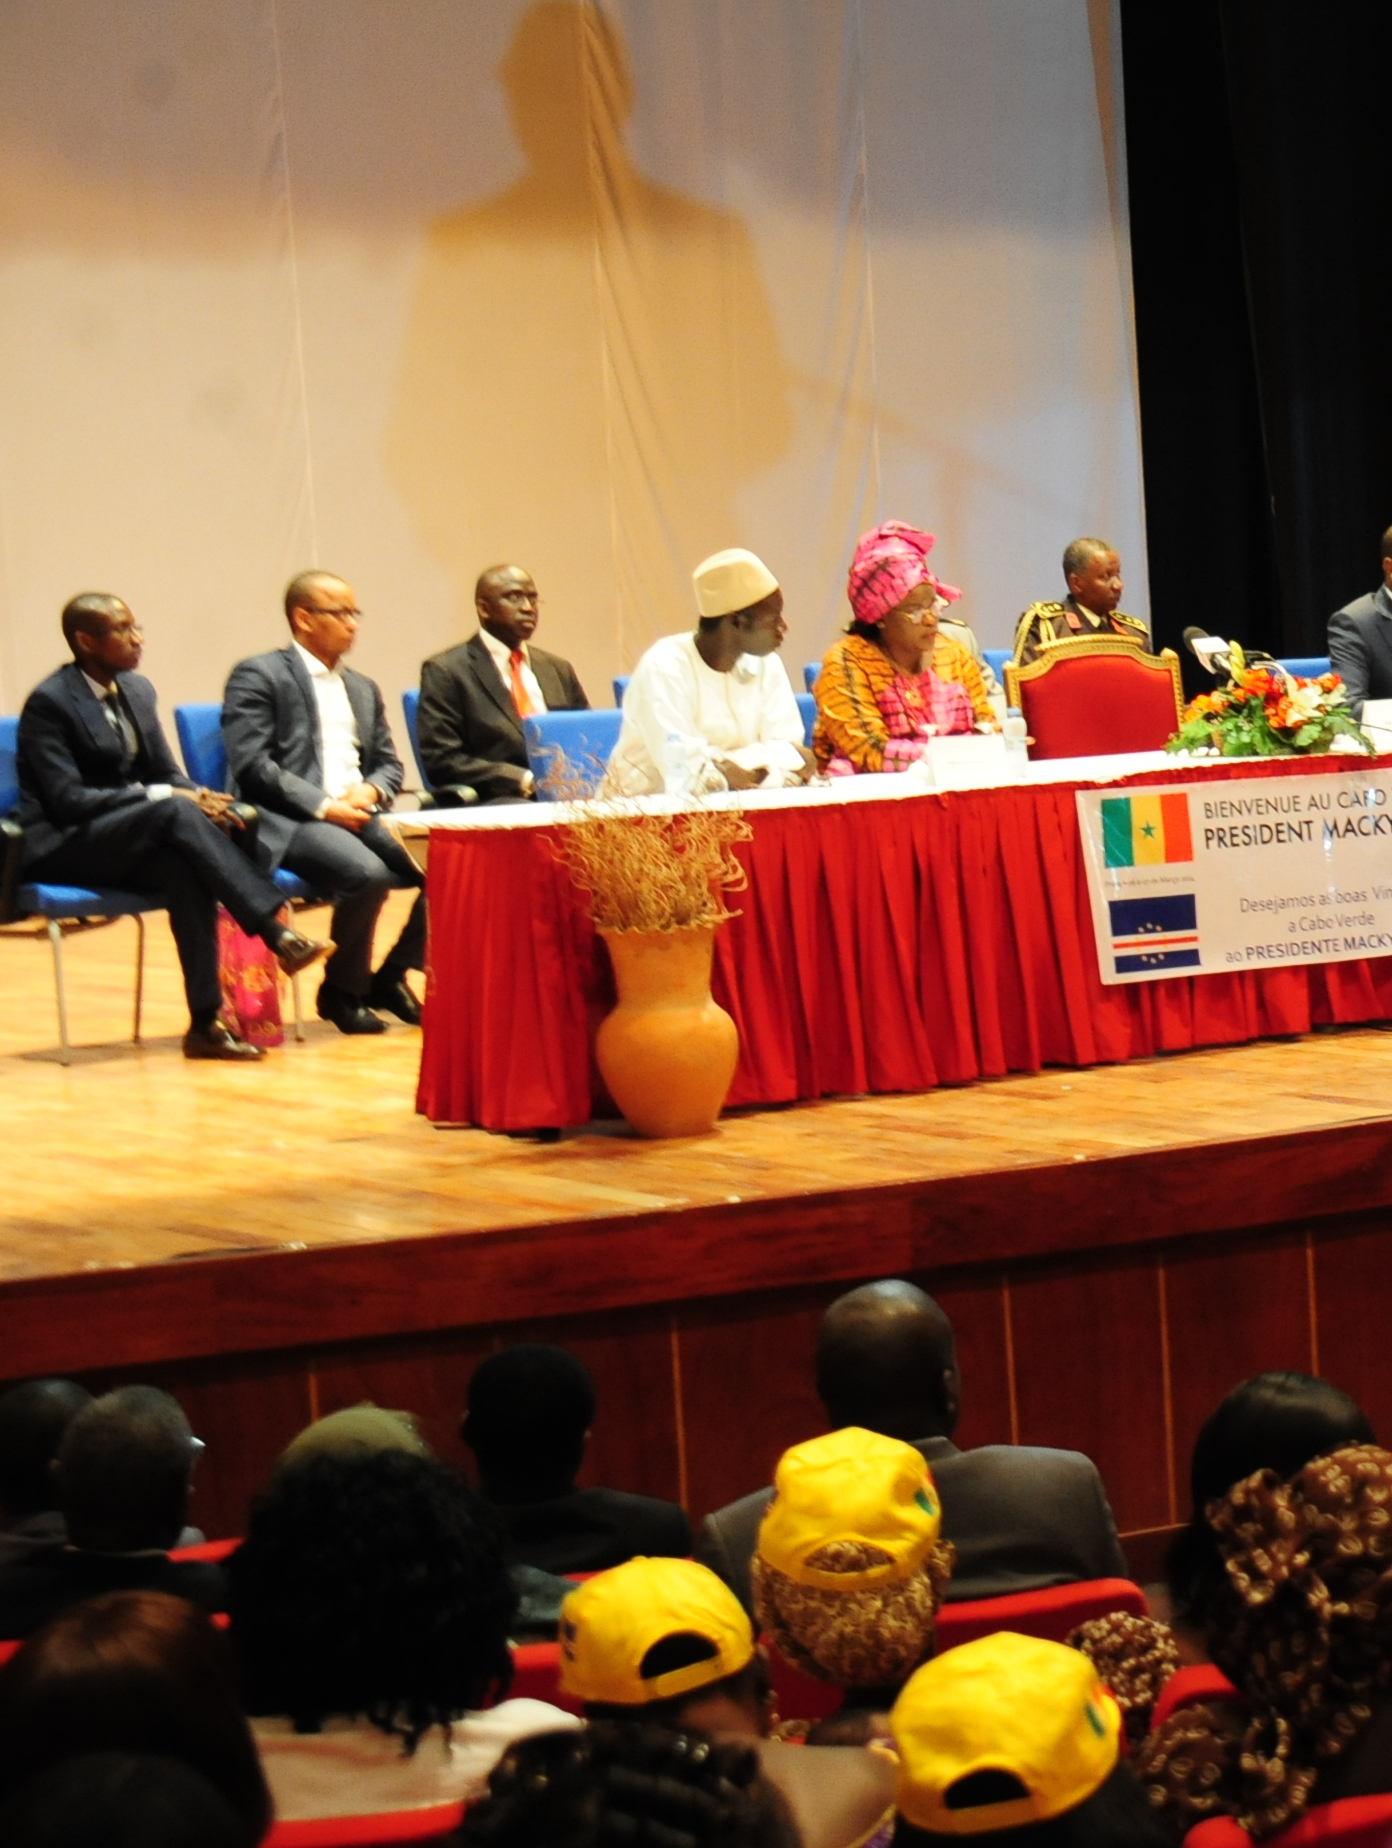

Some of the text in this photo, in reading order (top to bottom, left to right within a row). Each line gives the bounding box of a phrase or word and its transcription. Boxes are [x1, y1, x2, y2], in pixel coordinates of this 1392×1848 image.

[1203, 795, 1302, 819] BIENVENUE
[1307, 792, 1331, 811] AU
[1204, 820, 1314, 850] PRESIDENT
[1240, 895, 1315, 915] Desejamos
[1318, 894, 1332, 906] as
[1287, 910, 1375, 933] a Cabo Verde
[1225, 951, 1243, 963] ao
[1245, 938, 1340, 961] PRESIDENTE
